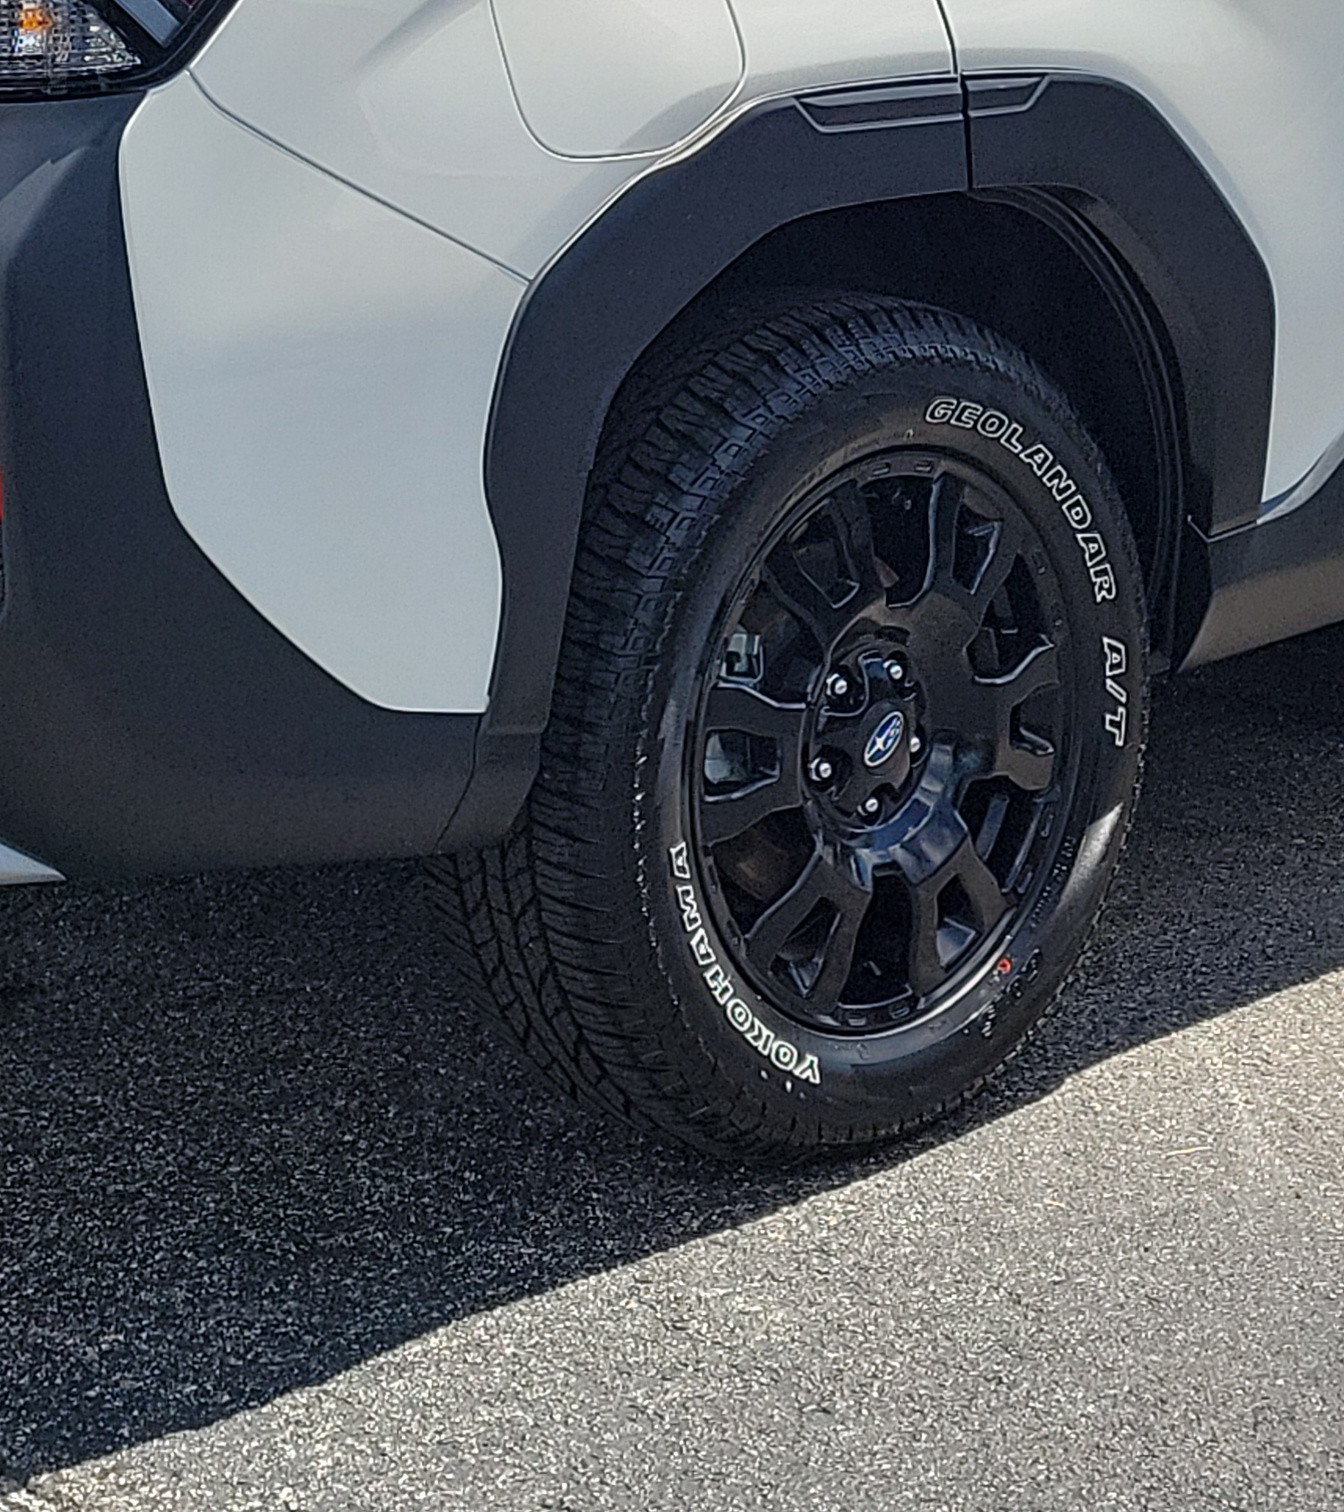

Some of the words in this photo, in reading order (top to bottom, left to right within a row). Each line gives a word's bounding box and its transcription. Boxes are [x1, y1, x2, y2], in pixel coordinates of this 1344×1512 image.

[925, 395, 1116, 603] GEOLANDAR
[1102, 636, 1128, 748] A/T
[669, 841, 821, 1085] YOKOHAMA
